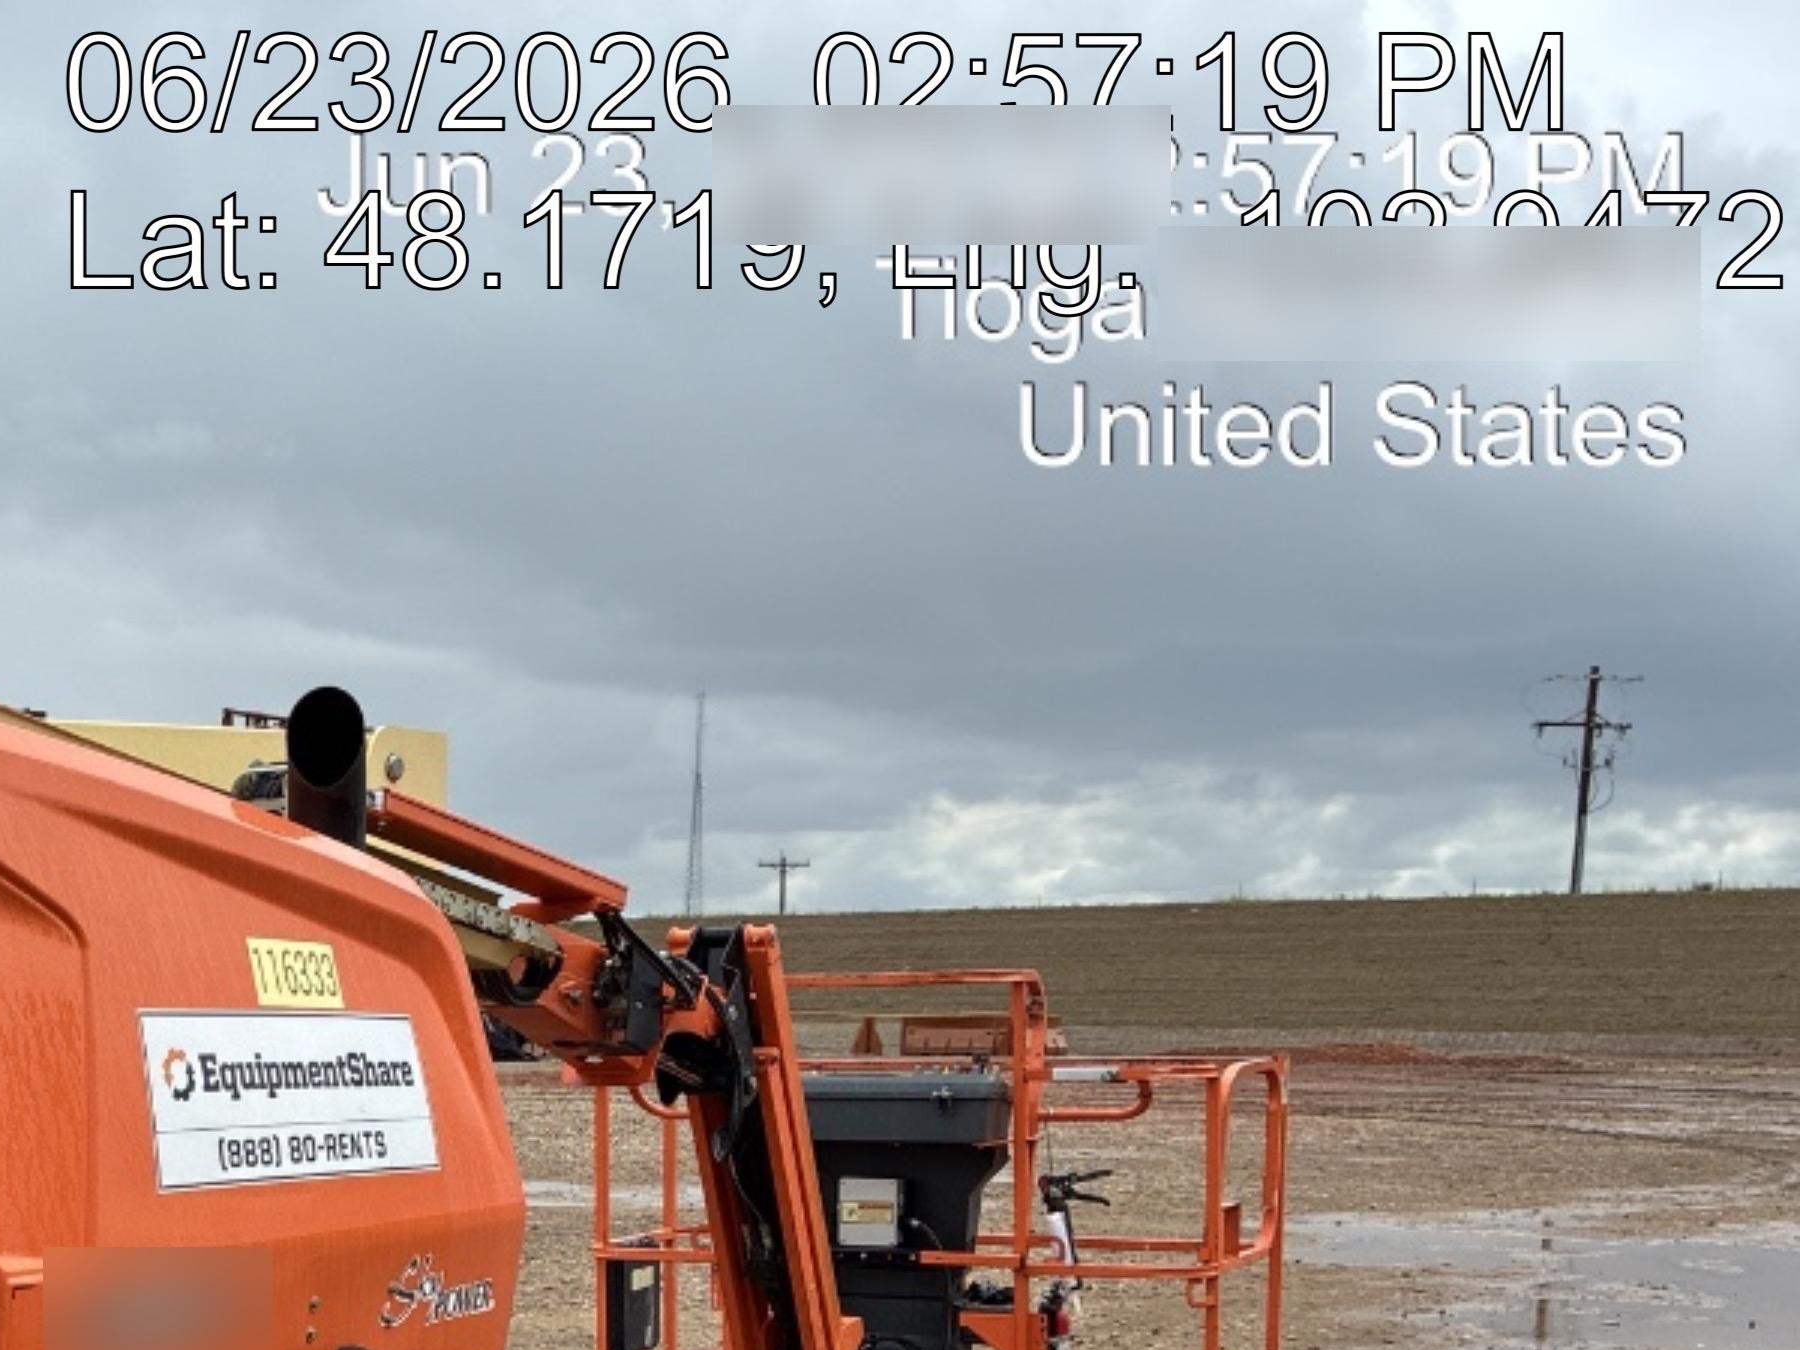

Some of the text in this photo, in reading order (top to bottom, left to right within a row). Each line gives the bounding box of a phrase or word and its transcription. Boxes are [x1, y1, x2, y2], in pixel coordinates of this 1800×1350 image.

[251, 948, 338, 997] 116333
[198, 1051, 415, 1100] EquipmentShare
[218, 1130, 388, 1171] (888) 80-RENTS
